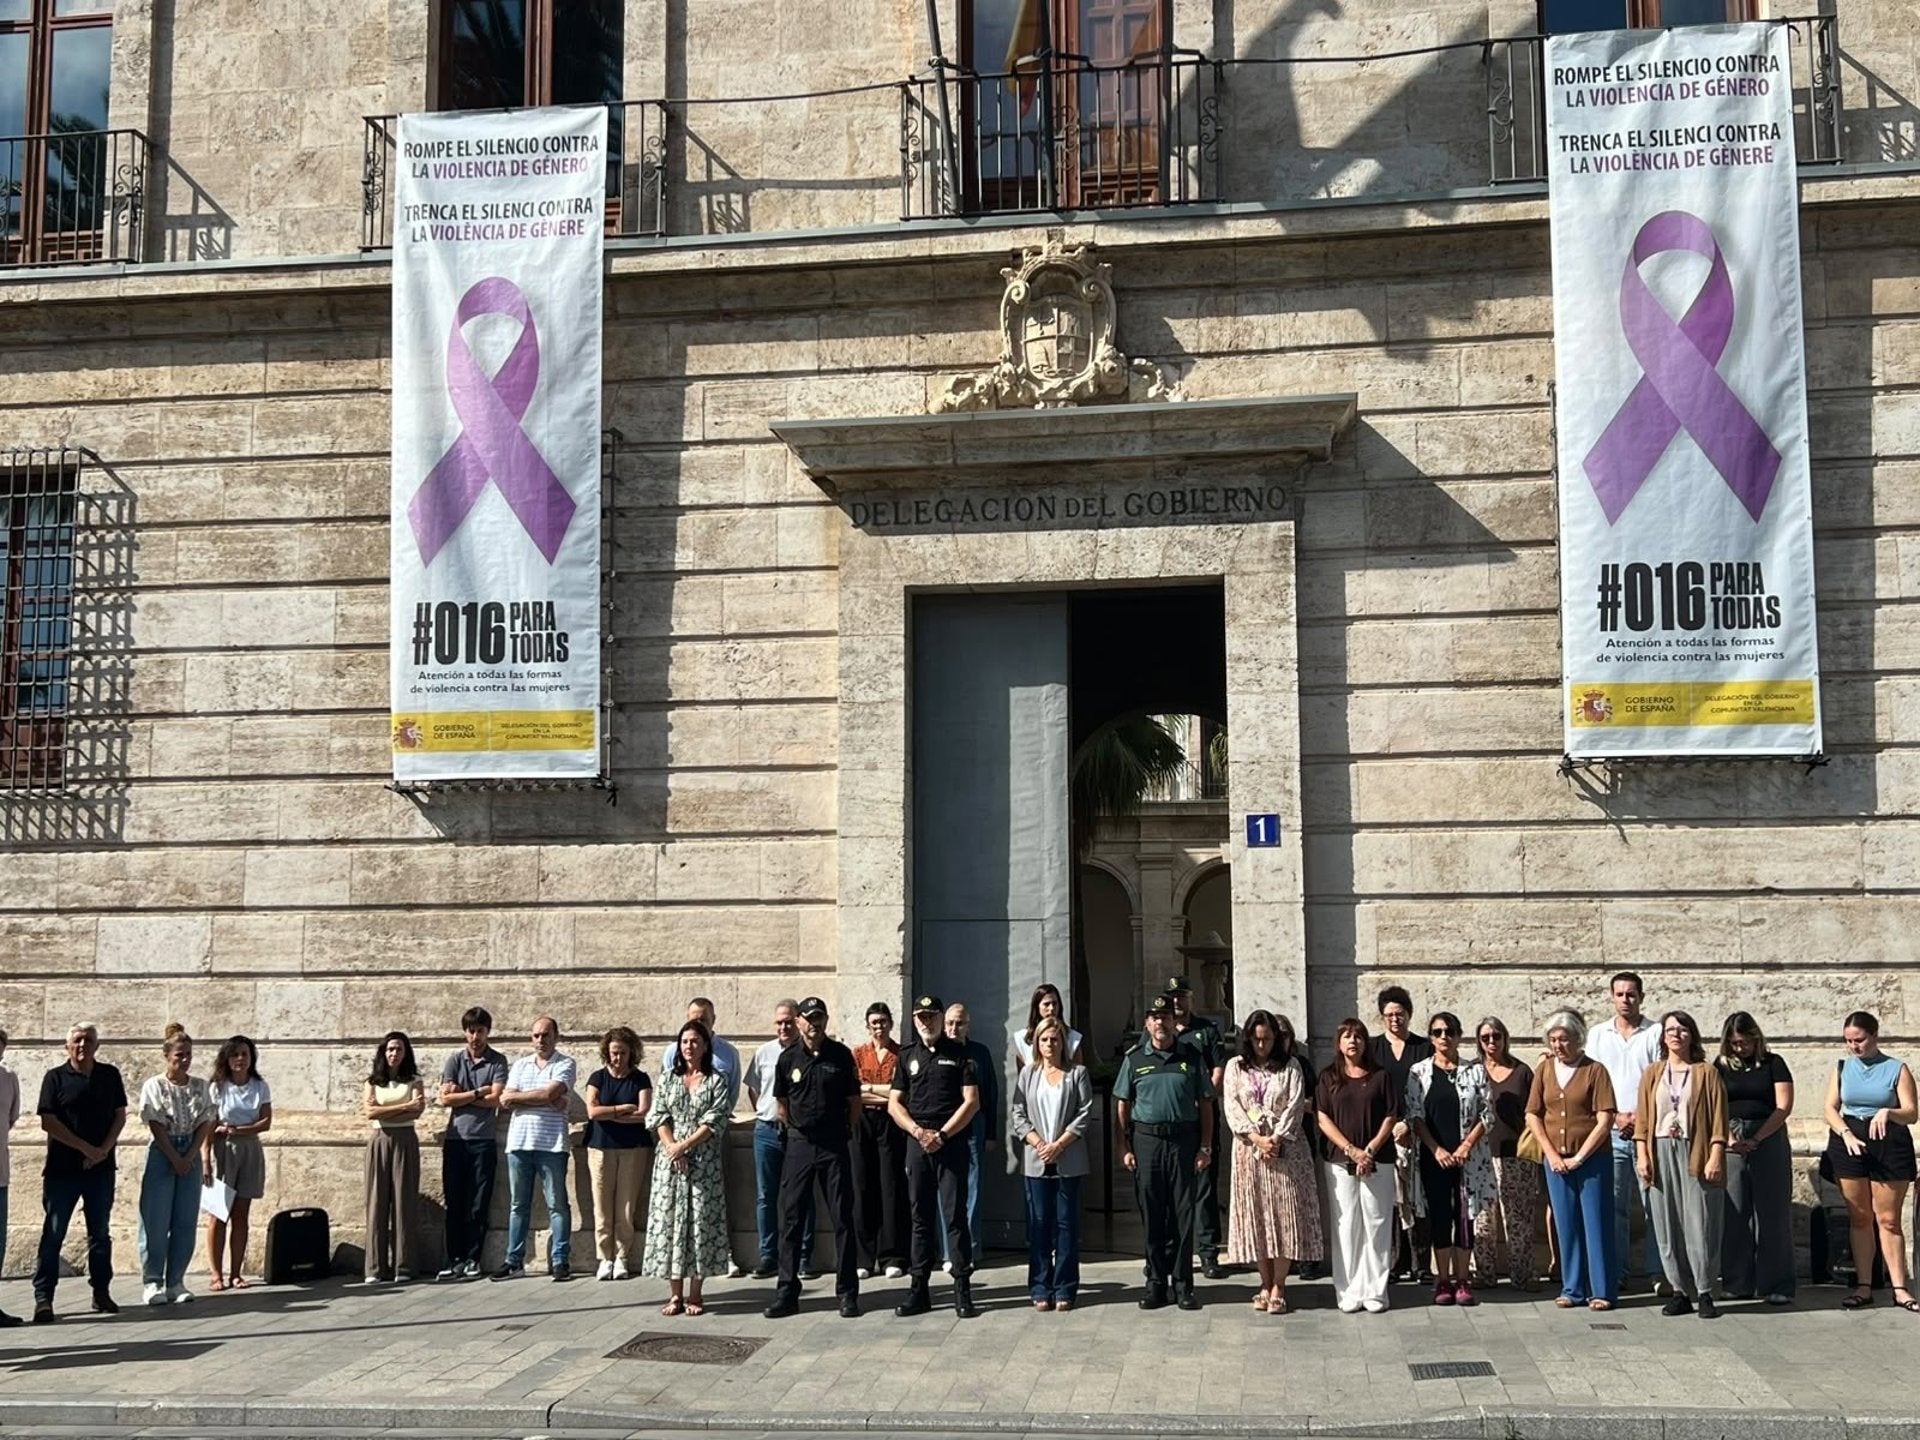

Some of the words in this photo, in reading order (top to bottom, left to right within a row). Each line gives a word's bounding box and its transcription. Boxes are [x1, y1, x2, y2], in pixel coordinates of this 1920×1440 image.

[1554, 66, 1611, 85] ROMPE
[1616, 65, 1634, 82] EL
[1638, 57, 1711, 80] SILENCIO
[1716, 54, 1780, 73] CONTRA
[1566, 89, 1585, 107] LA
[1589, 83, 1675, 106] VIOLENCIA
[1679, 81, 1700, 98] DE
[1705, 75, 1769, 96] GÉNERO
[404, 140, 453, 158] ROMPE
[457, 140, 472, 157] EL
[476, 137, 539, 156] SILENCIO
[543, 135, 599, 153] CONTRA
[1559, 132, 1623, 152] TRENCA
[1628, 130, 1646, 147] EL
[1650, 125, 1712, 147] SILENCI
[1716, 122, 1781, 142] CONTRA
[412, 163, 429, 179] LA
[434, 160, 506, 179] VIOLENCIA
[511, 159, 529, 176] DE
[532, 154, 588, 175] GÉNERO
[1570, 156, 1589, 174] LA
[1593, 149, 1679, 173] VIOLÈNCIA
[1685, 149, 1705, 168] DE
[1710, 144, 1774, 166] GÈNERE
[405, 203, 458, 222] TRENCA
[462, 203, 477, 220] EL
[481, 201, 534, 220] SILENCI
[538, 197, 593, 216] CONTRA
[412, 227, 427, 242] LA
[430, 221, 503, 241] VIOLÈNCIA
[509, 223, 527, 239] DE
[530, 219, 584, 238] GÈNERE
[851, 496, 1056, 528] DELEGACION
[1065, 493, 1116, 518] DEL
[1124, 486, 1286, 517] GOBIERNO
[1710, 562, 1765, 595] PARA
[1597, 561, 1706, 632] #016
[509, 601, 557, 632] PARA
[1710, 595, 1782, 630] TODAS
[412, 600, 506, 666] #016
[1606, 637, 1661, 649] Atención
[1665, 640, 1672, 648] a
[1675, 637, 1709, 648] todas
[1711, 637, 1728, 647] las
[1730, 636, 1775, 647] formas
[509, 632, 569, 664] TODAS
[1596, 653, 1611, 664] de
[1616, 652, 1669, 662] violencia
[1672, 652, 1711, 662] contra
[1715, 651, 1731, 661] las
[1734, 651, 1785, 663] mujeres
[418, 671, 465, 680] Atención
[476, 670, 506, 679] todas
[509, 670, 524, 679] las
[526, 669, 562, 679] formas
[410, 685, 424, 694] de
[426, 684, 471, 693] violencia
[473, 684, 508, 692] contra
[511, 683, 526, 692] las
[529, 683, 570, 694] mujeres
[1625, 696, 1675, 705] GOBIERNO
[1625, 704, 1638, 713] DE
[1640, 703, 1675, 712] ESPAÑA
[433, 724, 475, 733] GOBIERNO
[433, 732, 444, 740] DE
[445, 731, 476, 740] ESPAÑA
[1255, 817, 1266, 842] 1
